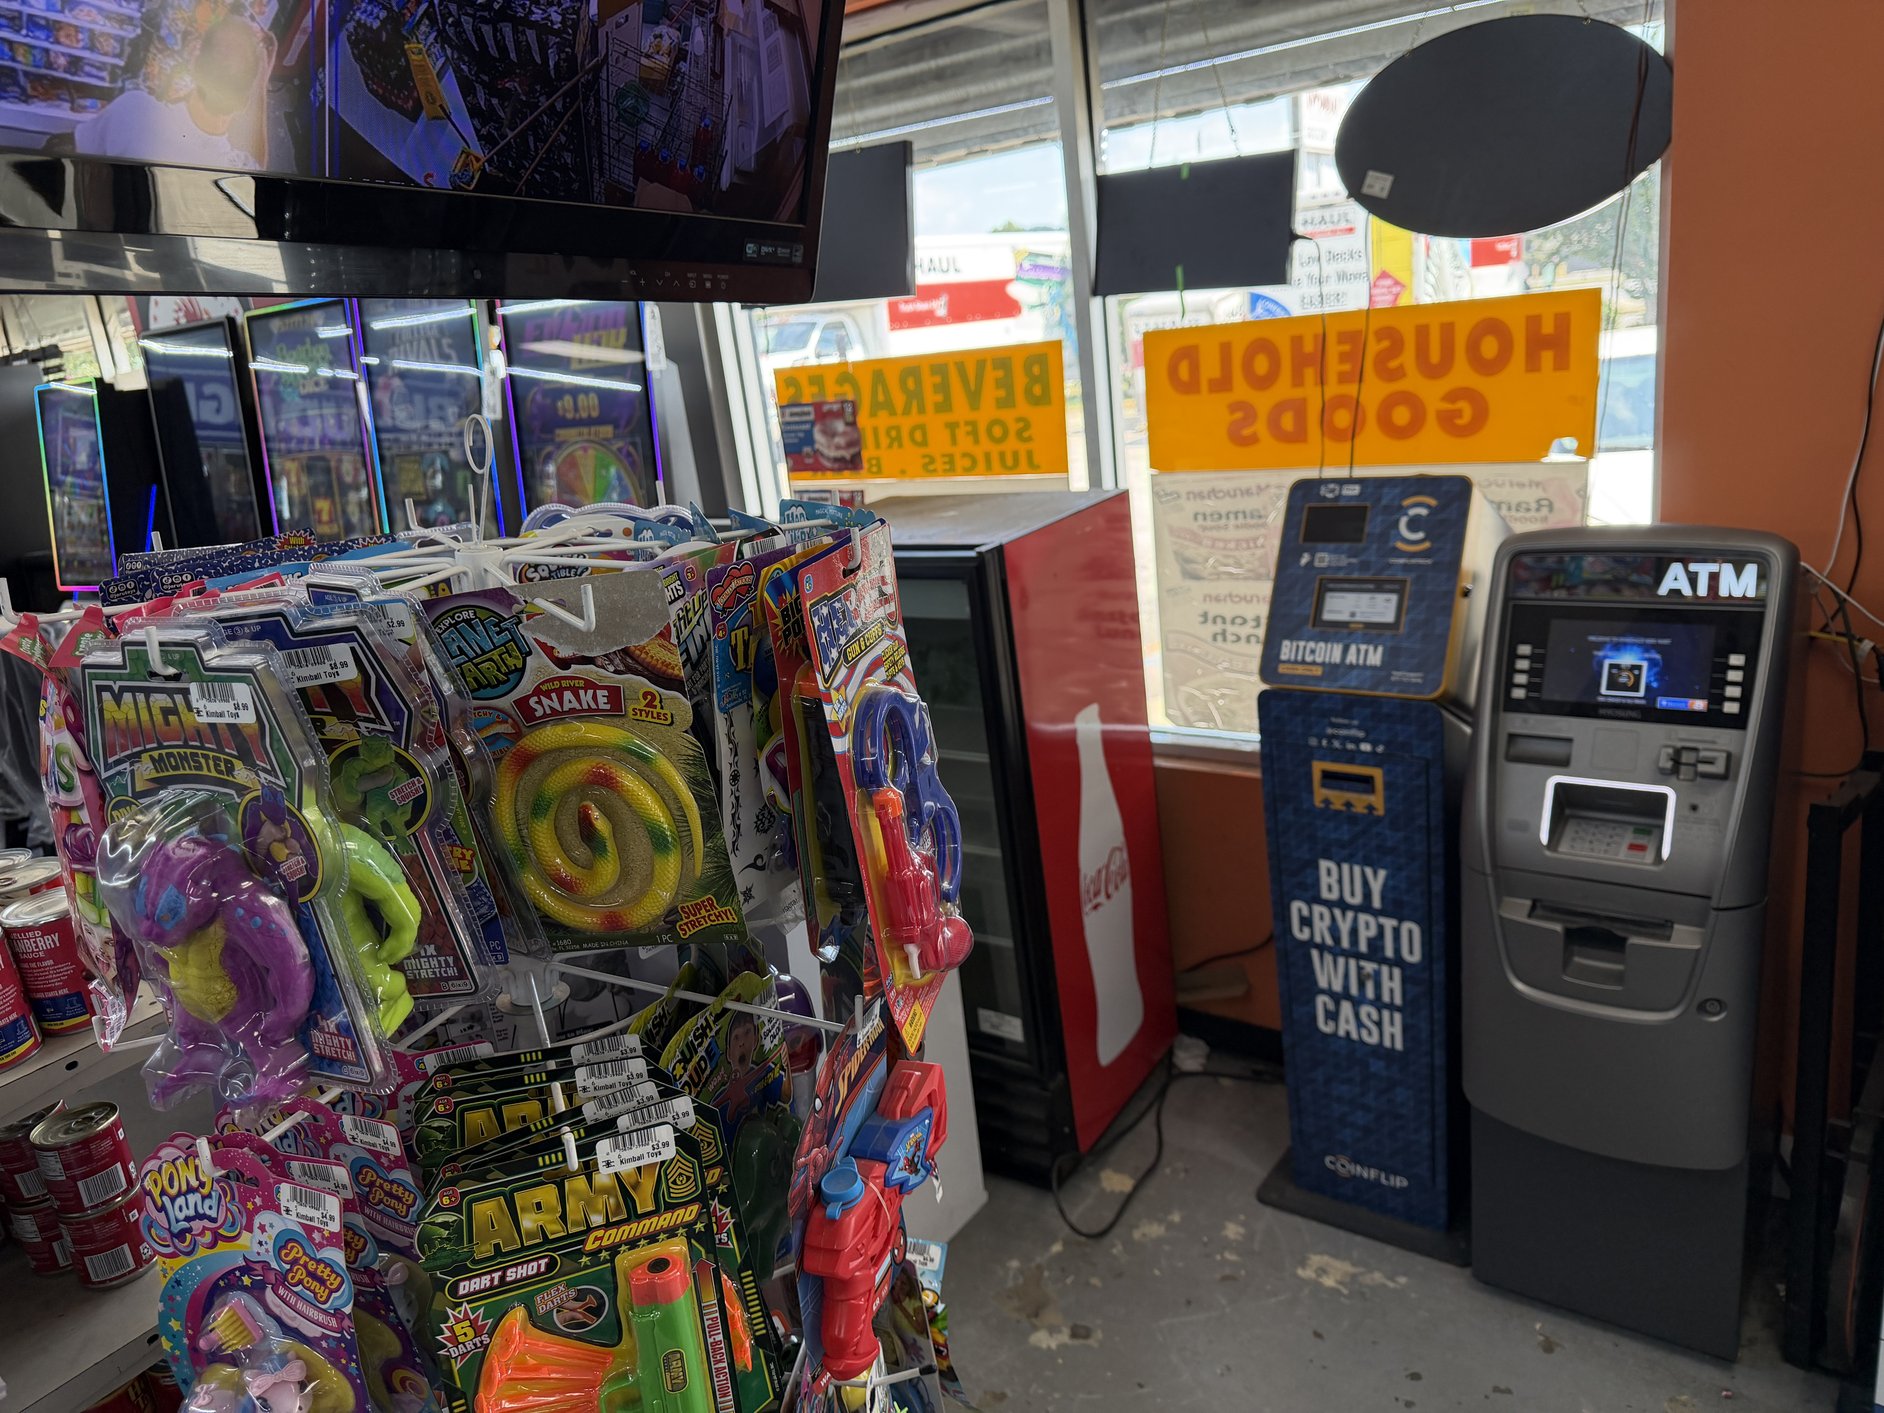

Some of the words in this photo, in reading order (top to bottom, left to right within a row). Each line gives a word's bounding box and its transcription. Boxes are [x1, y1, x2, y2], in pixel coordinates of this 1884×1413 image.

[1657, 562, 1758, 598] ATM
[435, 610, 476, 635] EXPLORE
[440, 617, 532, 663] ANET
[1280, 639, 1343, 665] BITCOIN
[1345, 642, 1384, 667] ATM
[296, 669, 322, 684] Kimball
[323, 667, 341, 679] Toys
[459, 641, 524, 690] ARTH
[539, 681, 560, 692] WILD
[562, 680, 584, 689] RIVER
[529, 689, 611, 717] SNAKE
[642, 691, 658, 709] 2
[205, 709, 226, 719] Kimball
[227, 711, 240, 721] Toys
[472, 709, 493, 719] TCHY
[631, 708, 668, 722] STYLES
[149, 752, 236, 779] MONSTER
[1318, 858, 1387, 910] BUY
[679, 898, 719, 920] SUPER
[678, 909, 736, 937] STRETCHY!
[1290, 900, 1422, 964] CRYPTO
[11, 931, 42, 940] ELLIED
[13, 932, 61, 953] ANBERRY
[404, 955, 455, 970] MIGHTY
[406, 968, 459, 980] STRETCH!
[1310, 948, 1403, 1006] WITH
[1315, 994, 1404, 1052] CASH
[313, 1043, 357, 1061] STRETCH!
[620, 1047, 637, 1056] $3.99
[593, 1083, 617, 1092] Kimball
[626, 1072, 644, 1081] $3.99
[437, 1104, 451, 1112] 6+
[636, 1094, 654, 1106] $3.99
[672, 1111, 690, 1121] $3.99
[359, 1138, 378, 1149] Kimball
[378, 1143, 390, 1152] Toys
[382, 1139, 397, 1148] $4.99
[651, 1141, 670, 1151] $3.99
[620, 1154, 645, 1166] Kimball
[646, 1150, 662, 1160] Toys
[1324, 1154, 1409, 1189] COINFLIP
[358, 1167, 416, 1205] Pretty
[162, 1192, 221, 1234] Land
[369, 1187, 409, 1219] Pony
[442, 1196, 457, 1206] 6+
[471, 1160, 660, 1260] ARMY
[295, 1212, 315, 1222] Kimball
[316, 1218, 329, 1228] Toys
[321, 1212, 336, 1222] $4.99
[364, 1206, 381, 1221] WITH
[383, 1216, 415, 1238] HAIRBRUS
[584, 1203, 699, 1251] COMMAND
[279, 1241, 344, 1288] Pretty
[287, 1265, 331, 1304] Pony
[457, 1271, 503, 1297] DART
[505, 1258, 550, 1282] SHOT
[536, 1282, 567, 1304] FLEX
[538, 1288, 577, 1315] DARTS
[277, 1285, 297, 1302] WITH
[296, 1297, 338, 1328] HAIRBRUSH
[452, 1320, 475, 1343] 5
[706, 1315, 726, 1366] PULL-BACK
[448, 1334, 491, 1359] DARTS
[713, 1364, 733, 1399] ACTION
